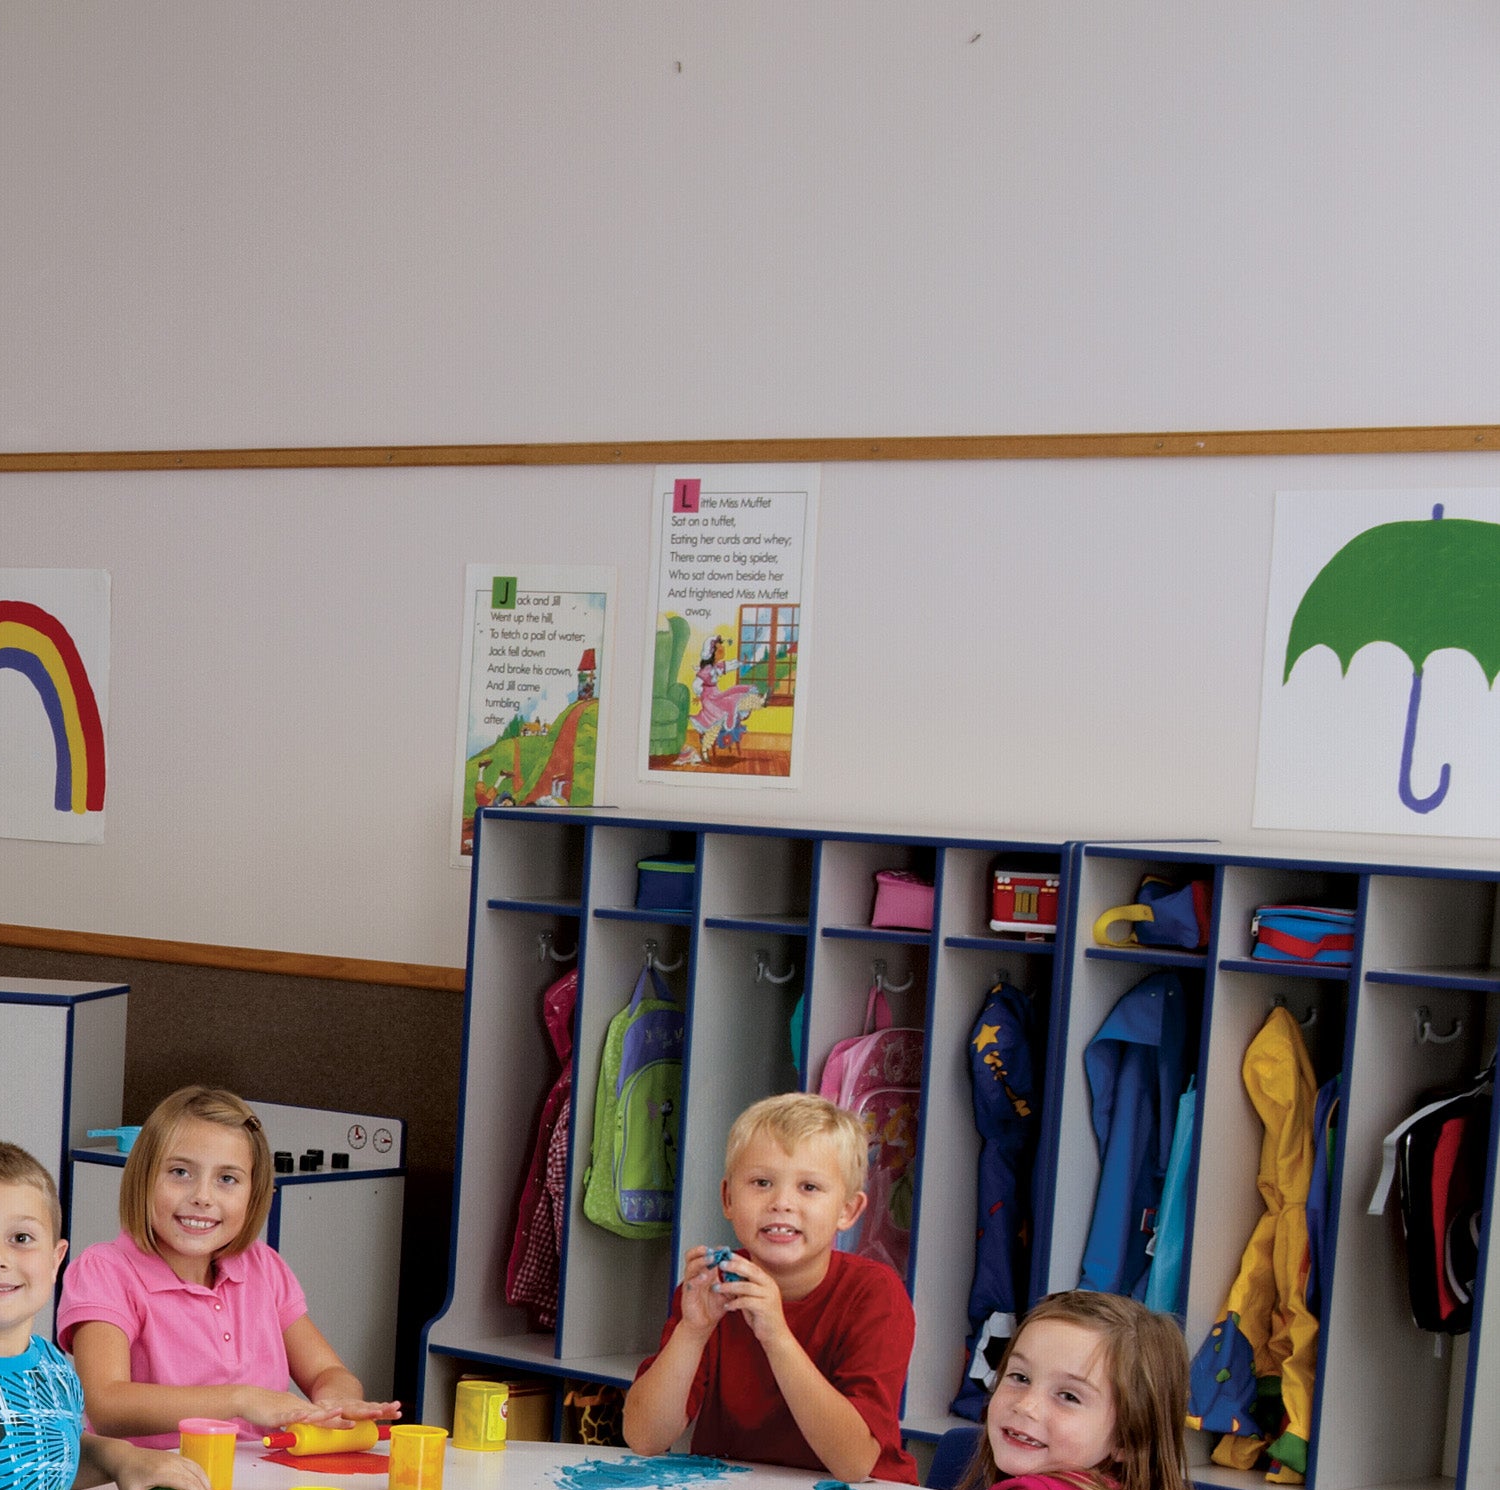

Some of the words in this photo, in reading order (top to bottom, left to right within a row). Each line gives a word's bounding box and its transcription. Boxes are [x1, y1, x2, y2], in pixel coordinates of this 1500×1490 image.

[719, 498, 738, 508] Miss
[740, 497, 772, 508] Muffet
[671, 515, 686, 527] Sat
[688, 517, 700, 527] on
[701, 518, 709, 527] a
[711, 515, 736, 528] tuffet,
[670, 534, 698, 547] Eating
[700, 534, 715, 545] her
[716, 534, 741, 545] curds
[742, 534, 761, 545] and
[670, 551, 695, 563] There
[696, 554, 721, 563] came
[723, 554, 730, 563] a
[732, 552, 747, 566] big
[749, 552, 779, 566] spider,
[668, 569, 690, 581] Who
[691, 570, 705, 581] sat
[706, 570, 734, 581] down
[735, 570, 766, 581] beside
[768, 570, 784, 581] her
[533, 595, 550, 606] and
[551, 595, 561, 606] Jill
[667, 588, 687, 598] And
[688, 588, 734, 601] frightened
[735, 588, 755, 599] Miss
[757, 588, 789, 599] Muffet
[490, 612, 511, 622] Went
[514, 614, 525, 624] up
[526, 613, 540, 623] the
[489, 628, 499, 639] To
[501, 629, 520, 640] fetch
[522, 632, 529, 640] a
[530, 630, 546, 642] pail
[547, 630, 557, 641] of
[488, 646, 506, 657] Jack
[508, 647, 519, 657] fell
[521, 647, 546, 658] down
[486, 663, 506, 674] And
[507, 664, 531, 675] broke
[532, 665, 543, 675] his
[486, 680, 504, 691] And
[506, 680, 516, 692] Jill
[516, 683, 541, 693] came
[485, 698, 520, 711] tumbling
